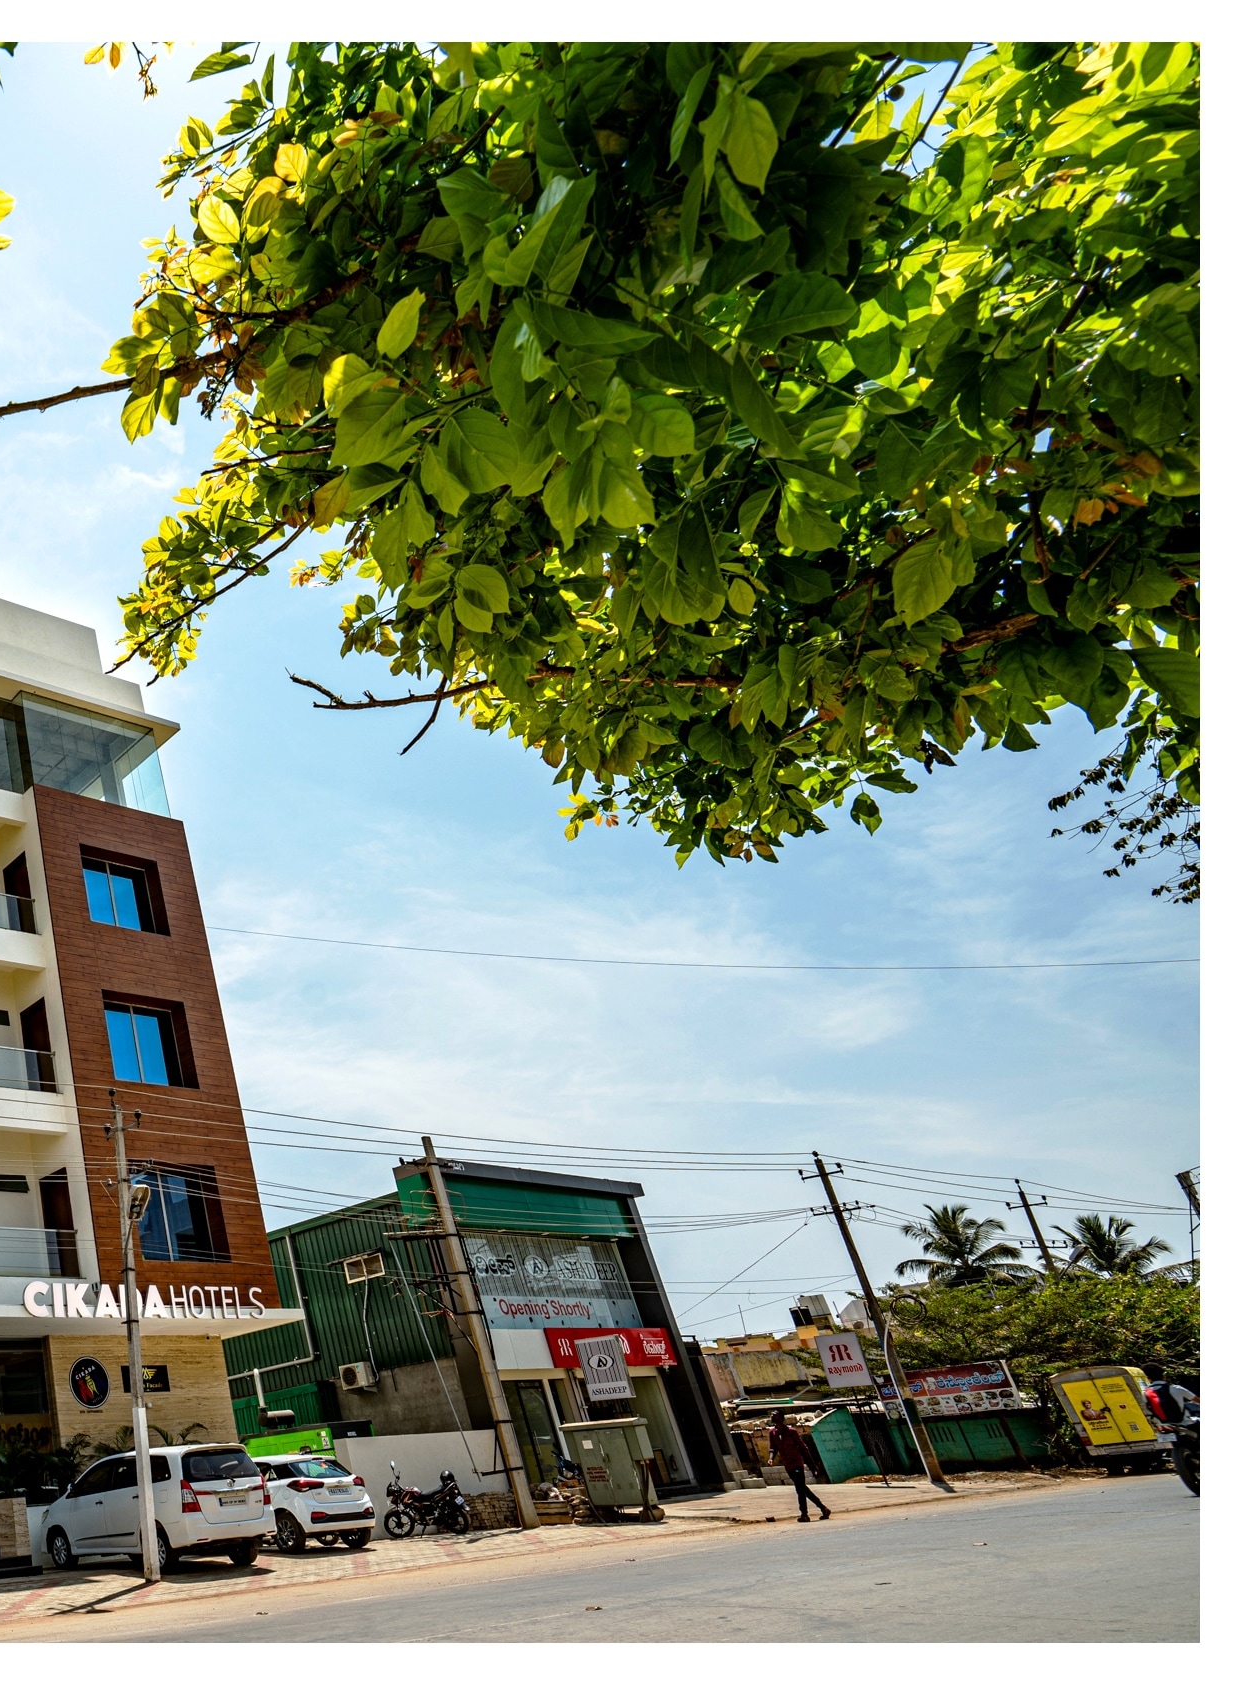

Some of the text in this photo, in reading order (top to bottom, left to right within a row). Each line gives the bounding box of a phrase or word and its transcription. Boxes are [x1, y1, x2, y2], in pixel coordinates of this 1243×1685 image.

[169, 1284, 266, 1319] HOTELS
[498, 1298, 591, 1320] Opening Shortly
[75, 1365, 96, 1380] CIKADA
[591, 1385, 628, 1396] ASHADEEP
